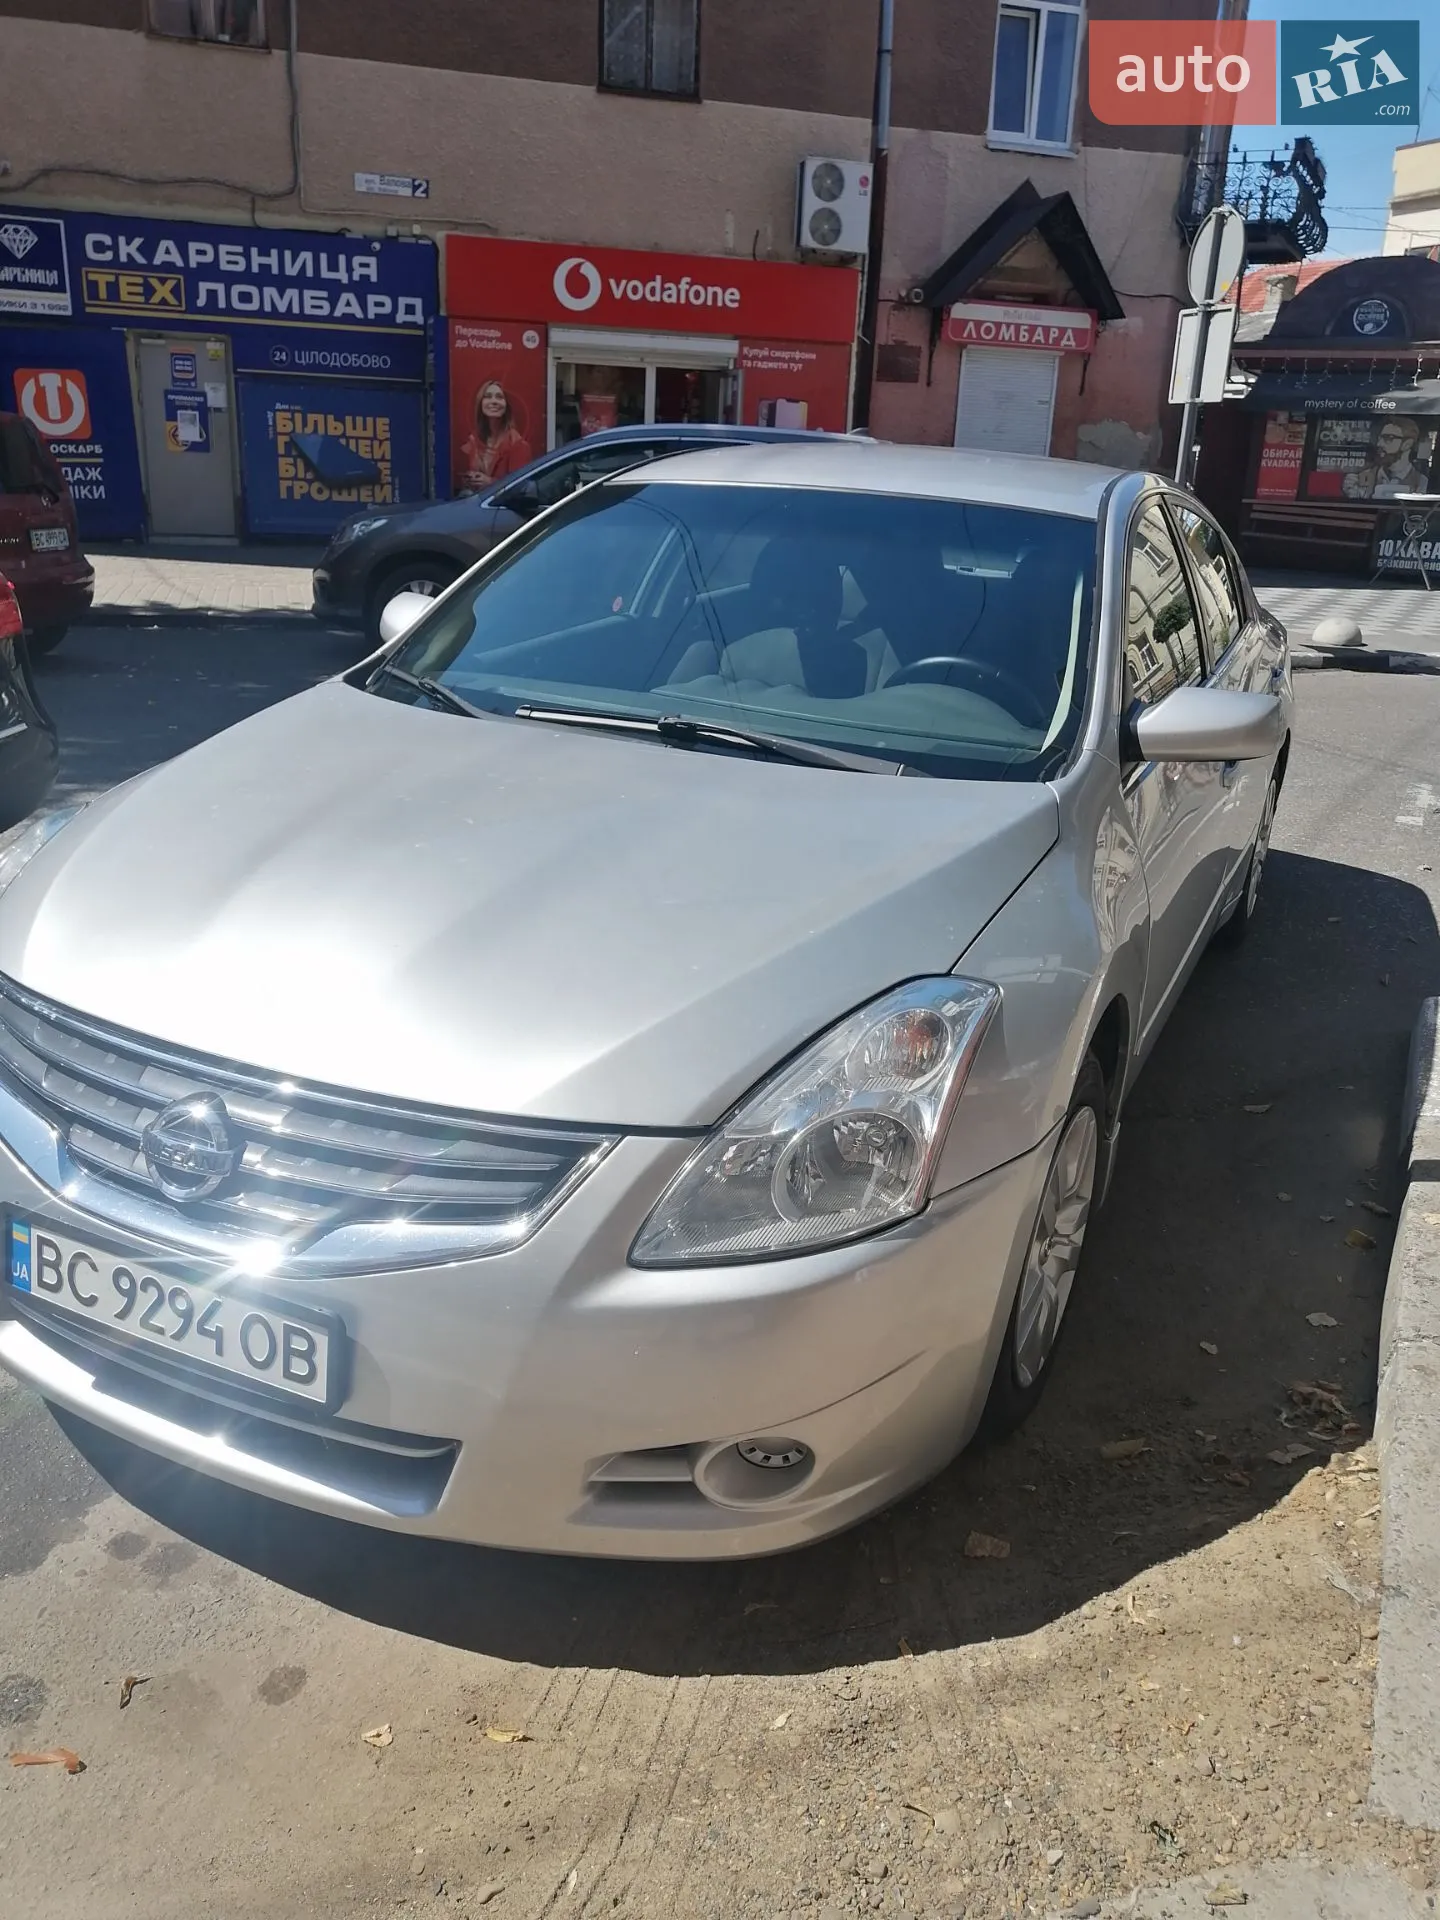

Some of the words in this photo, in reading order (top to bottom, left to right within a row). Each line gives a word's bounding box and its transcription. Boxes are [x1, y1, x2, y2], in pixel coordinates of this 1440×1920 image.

[413, 179, 428, 197] 2
[84, 232, 379, 284] СКАРБНИЦЯ
[87, 271, 181, 306] ТЕХ
[196, 281, 424, 325] ЛОМБАРД
[608, 274, 741, 308] vodafone
[455, 325, 502, 337] Переходь
[962, 320, 1077, 348] ЛОМБАРД
[455, 339, 468, 348] до
[469, 338, 513, 350] Vodafone
[273, 350, 287, 362] 24
[294, 350, 391, 369] ЦІЛОДОБОВО
[742, 347, 769, 358] Купуй
[770, 349, 817, 361] смартфони
[742, 360, 752, 368] та
[753, 360, 788, 370] гаджети
[789, 362, 803, 372] тут
[1304, 399, 1344, 410] mystery
[1346, 398, 1358, 409] of
[1360, 398, 1397, 410] coffee
[275, 411, 391, 440] БІЛЬШЕ
[50, 444, 104, 454] ОСКАРБ
[1262, 447, 1303, 459] ОБИРАЙ
[1261, 459, 1302, 468] KVADRAT
[1316, 456, 1366, 468] настрою
[61, 467, 104, 482] ДАЖ
[1378, 539, 1394, 557] 10
[36, 1234, 99, 1308] BC
[111, 1265, 225, 1357] 9294
[239, 1312, 317, 1385] OB
